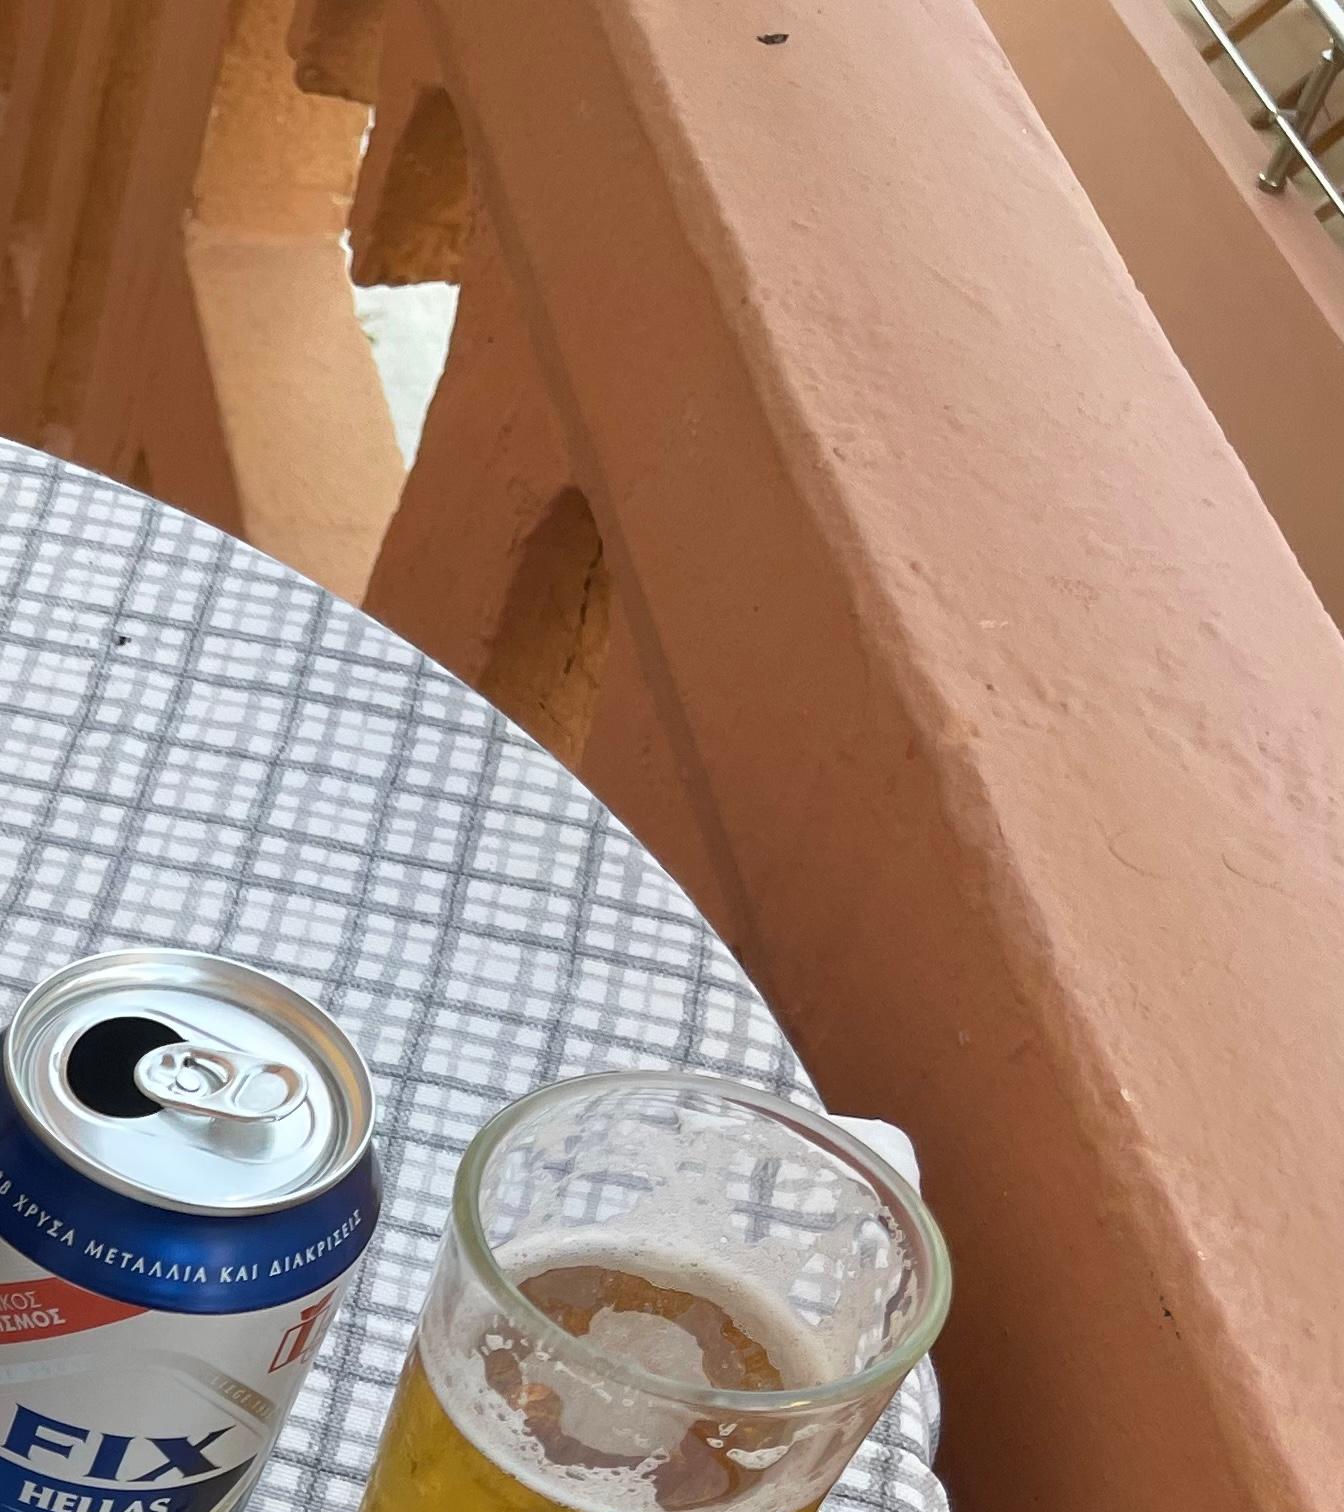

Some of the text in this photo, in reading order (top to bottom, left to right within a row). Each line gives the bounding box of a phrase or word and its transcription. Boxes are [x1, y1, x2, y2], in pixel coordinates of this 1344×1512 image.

[12, 1194, 76, 1247] ΧΡΥΣΑ
[84, 1240, 208, 1283] ΜΕΤΑΛΛΙΑ
[219, 1263, 259, 1284] ΚΑΙ
[268, 1208, 362, 1278] ΔΙΑΚΡΙΣΕΙΣ
[1, 1402, 237, 1483] FIX
